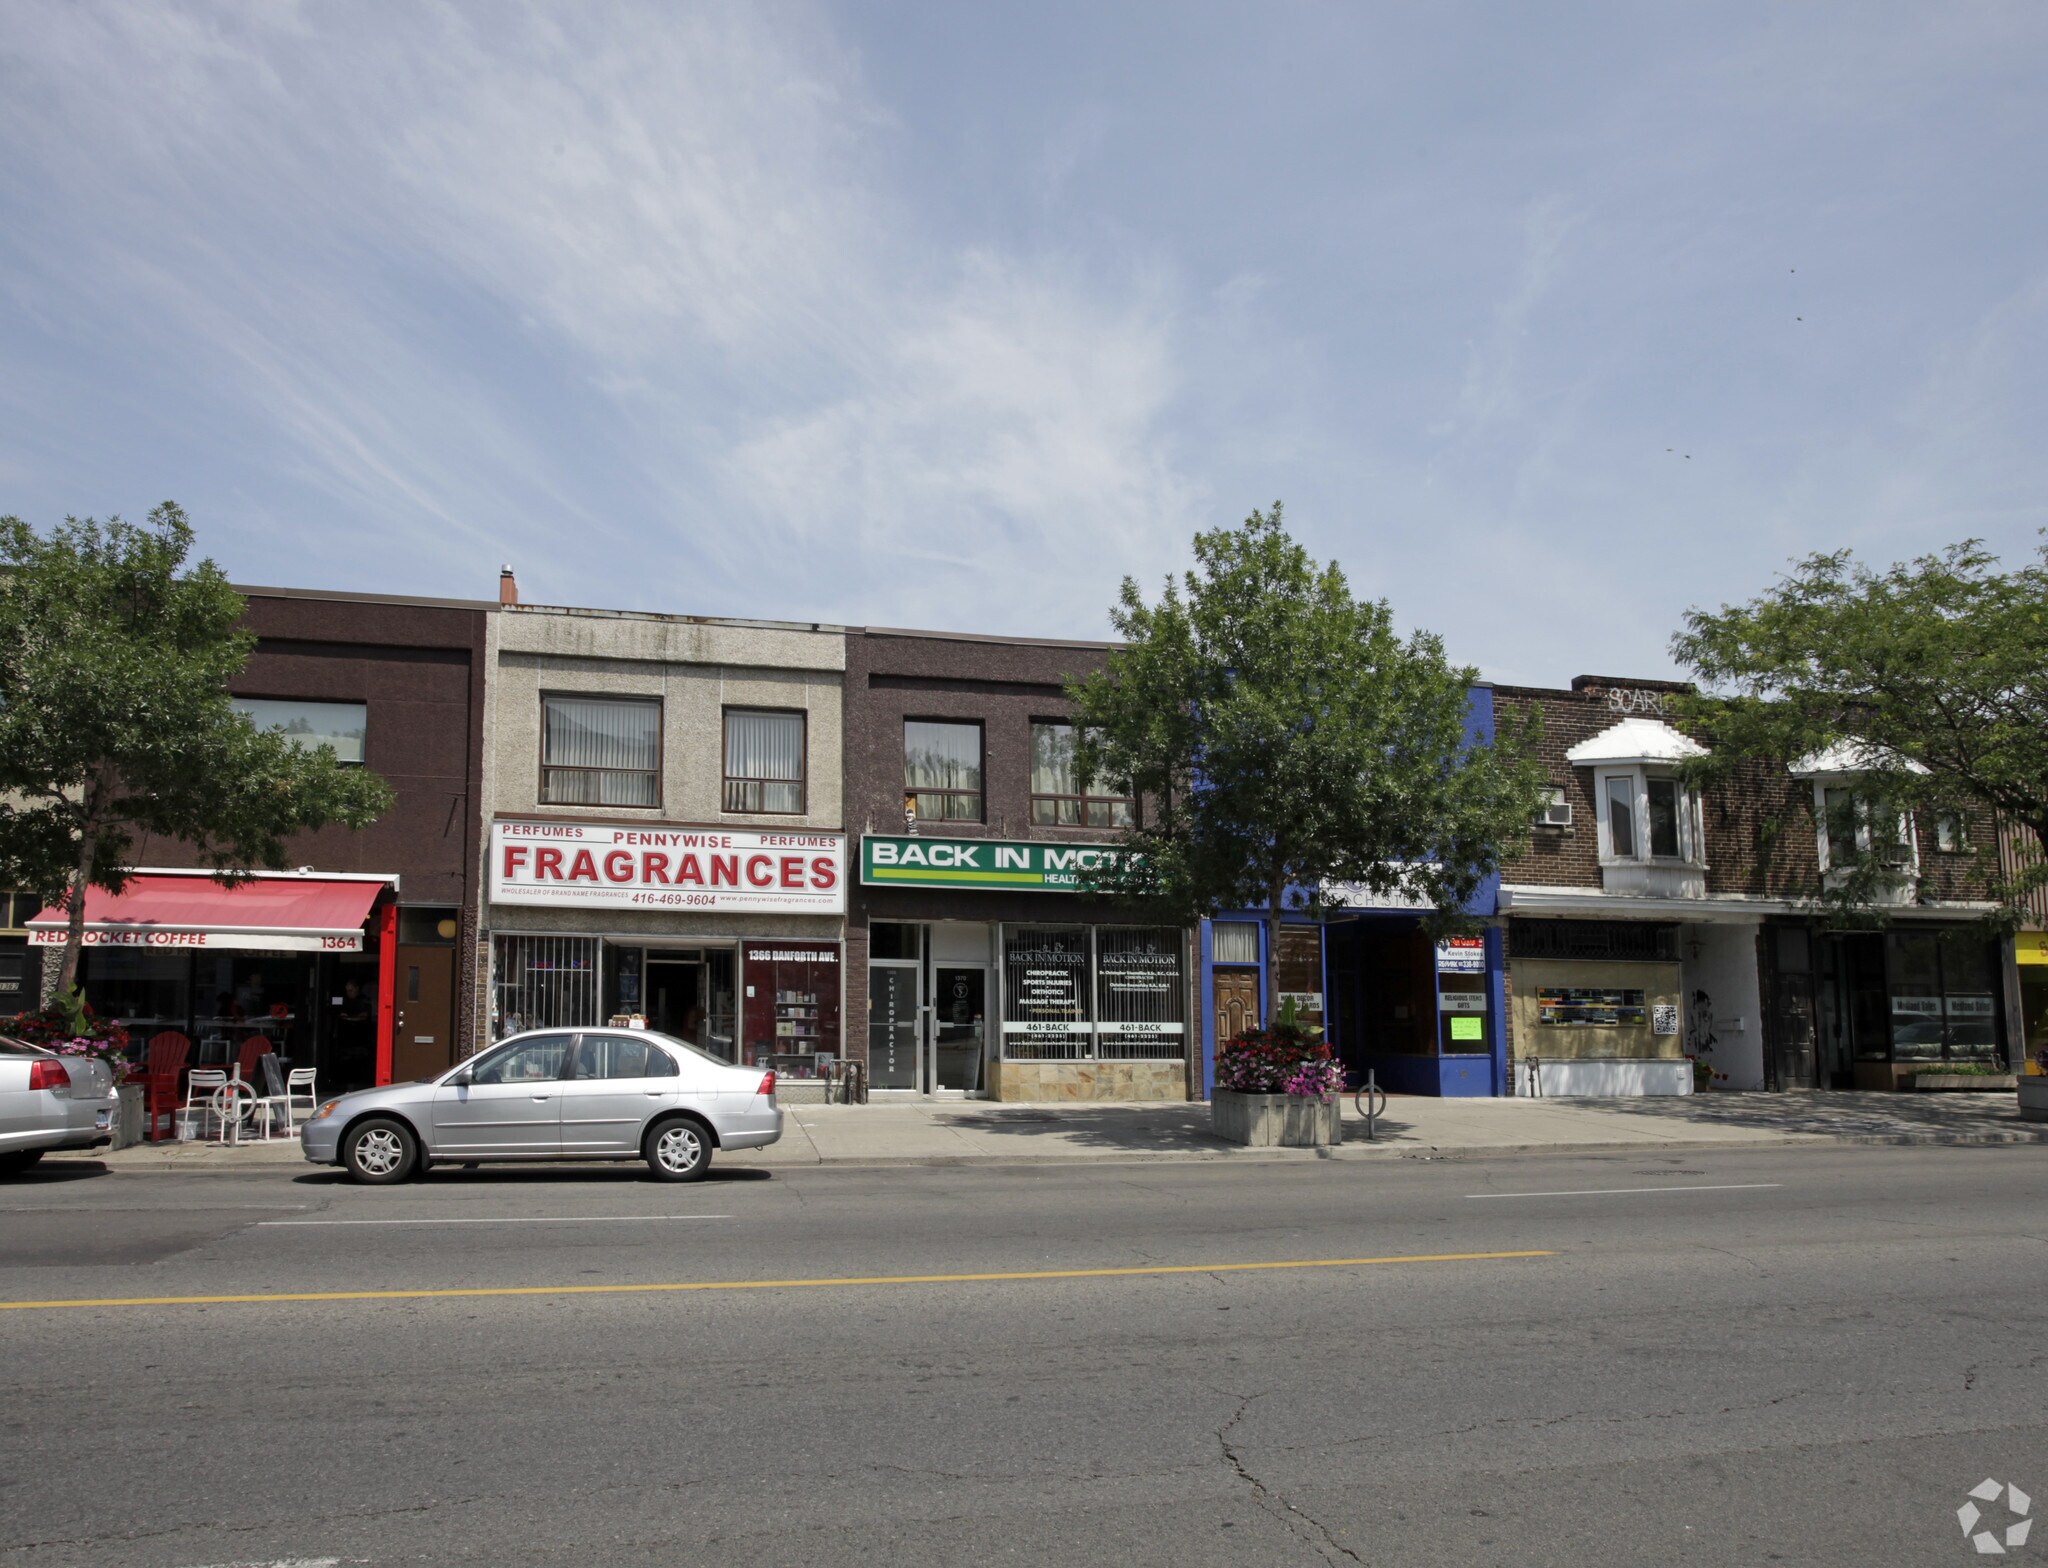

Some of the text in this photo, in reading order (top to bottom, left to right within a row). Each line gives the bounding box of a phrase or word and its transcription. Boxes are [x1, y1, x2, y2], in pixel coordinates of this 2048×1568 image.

[502, 825, 583, 838] PERFUMES
[613, 831, 732, 849] PENNYWISE
[760, 835, 836, 847] PERFUMES
[872, 842, 980, 868] BACK
[995, 847, 1030, 869] IN
[503, 846, 837, 889] FRAGRANCES
[1044, 873, 1079, 884] HEALT
[501, 887, 541, 895] WHOLESALER
[589, 891, 629, 899] FRAGRANCES
[631, 893, 716, 906] 416-469-9604
[720, 895, 834, 904] www.pennywisefragrances.com
[35, 930, 207, 945] RED OCKET COFFEE
[321, 936, 357, 949] 1364
[748, 950, 839, 963] 1366 DANFORTH AVE.
[1009, 953, 1085, 963] BACK IN MOTION
[1103, 955, 1176, 964] BACK IN MOTION
[1026, 1023, 1070, 1031] 461-BACK
[1119, 1024, 1162, 1032] 461-BACK
